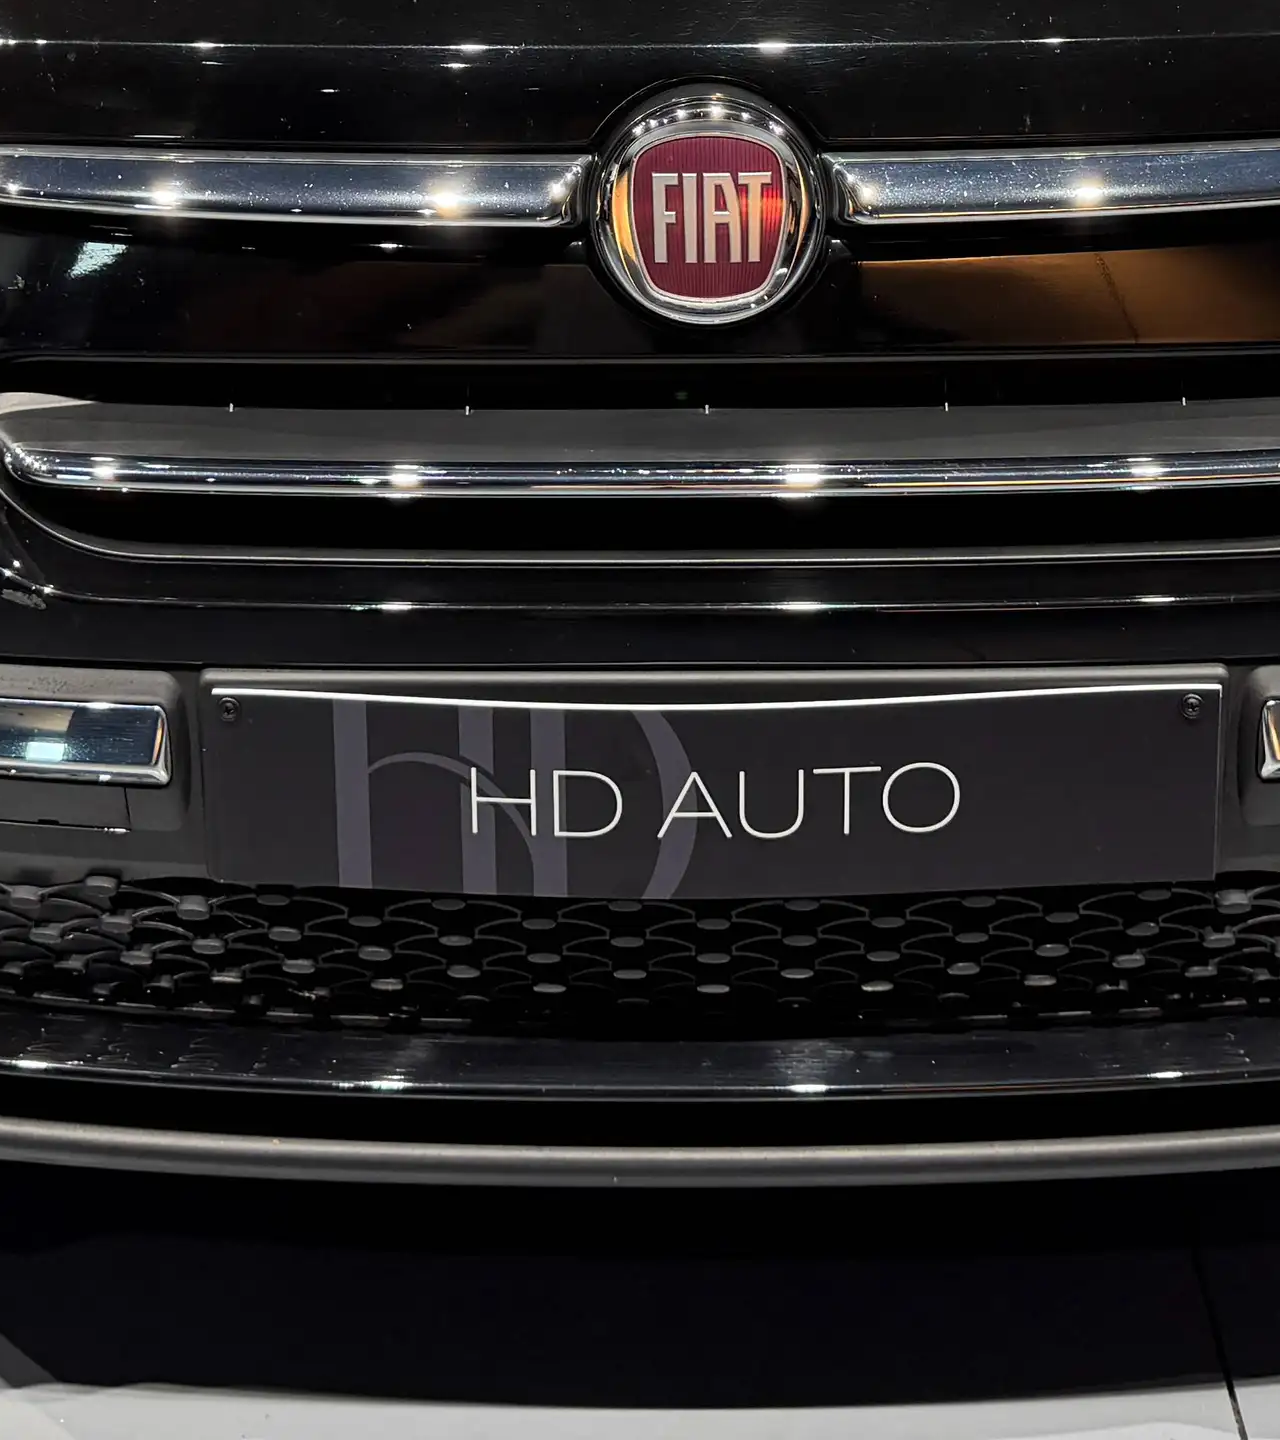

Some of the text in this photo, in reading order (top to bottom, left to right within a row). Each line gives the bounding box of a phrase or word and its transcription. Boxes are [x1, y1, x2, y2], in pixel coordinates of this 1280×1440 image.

[652, 171, 772, 264] FIAT
[470, 762, 961, 839] HD AUTO
